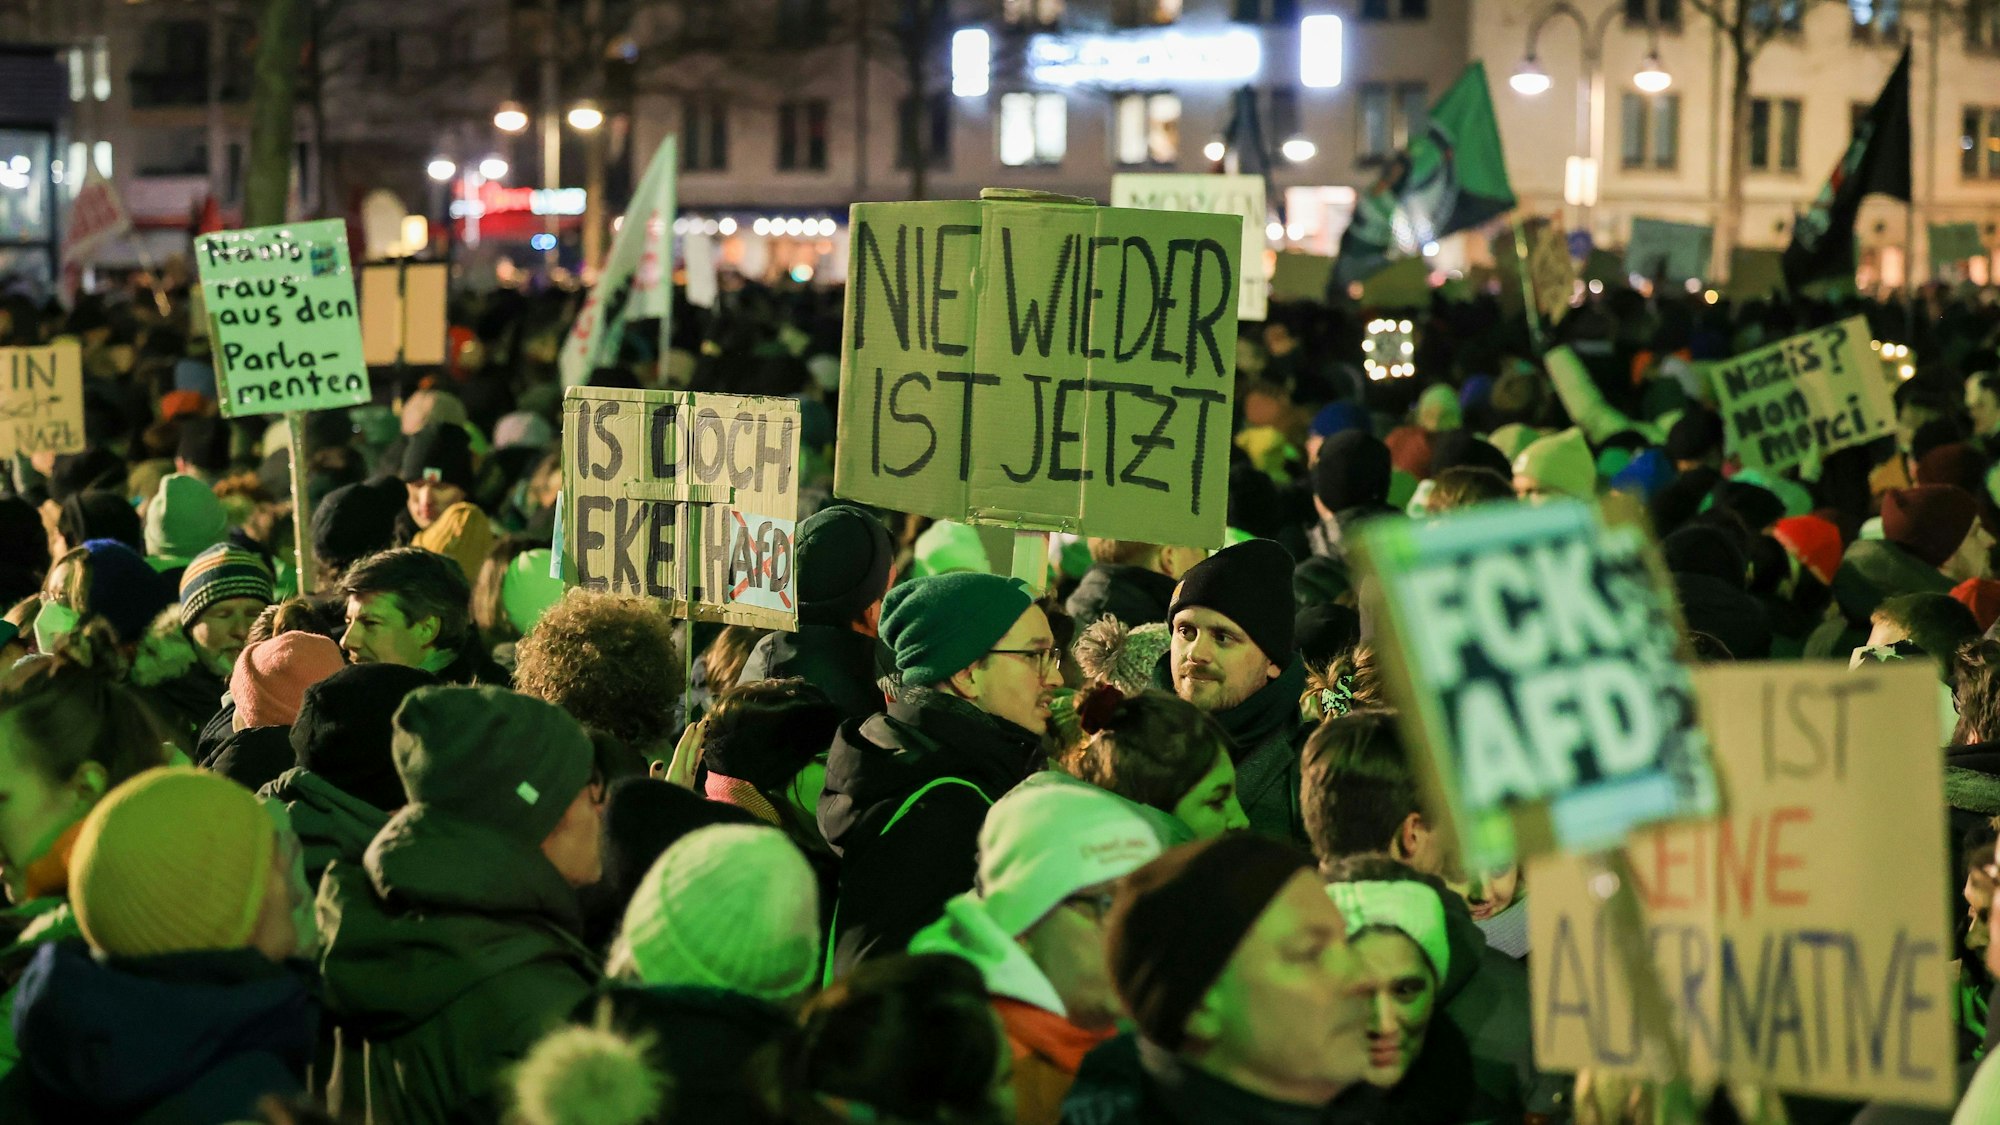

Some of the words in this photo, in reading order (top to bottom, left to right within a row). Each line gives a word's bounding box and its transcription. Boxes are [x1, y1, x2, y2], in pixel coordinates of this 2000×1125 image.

[217, 276, 298, 299] raus
[220, 304, 282, 328] aus
[296, 295, 353, 323] den
[854, 221, 982, 357] NIE
[1002, 227, 1232, 379] WIEDER
[0, 351, 57, 391] IN
[222, 341, 340, 371] Parla-
[238, 370, 363, 405] menten
[577, 400, 623, 482] IS
[651, 404, 794, 494] DOCH
[871, 367, 1001, 482] IST
[1001, 373, 1227, 516] JETZT
[1402, 544, 1622, 688] FCK
[1458, 659, 1662, 806] AFD
[1760, 675, 1884, 783] IST
[1624, 806, 1815, 921] EINE
